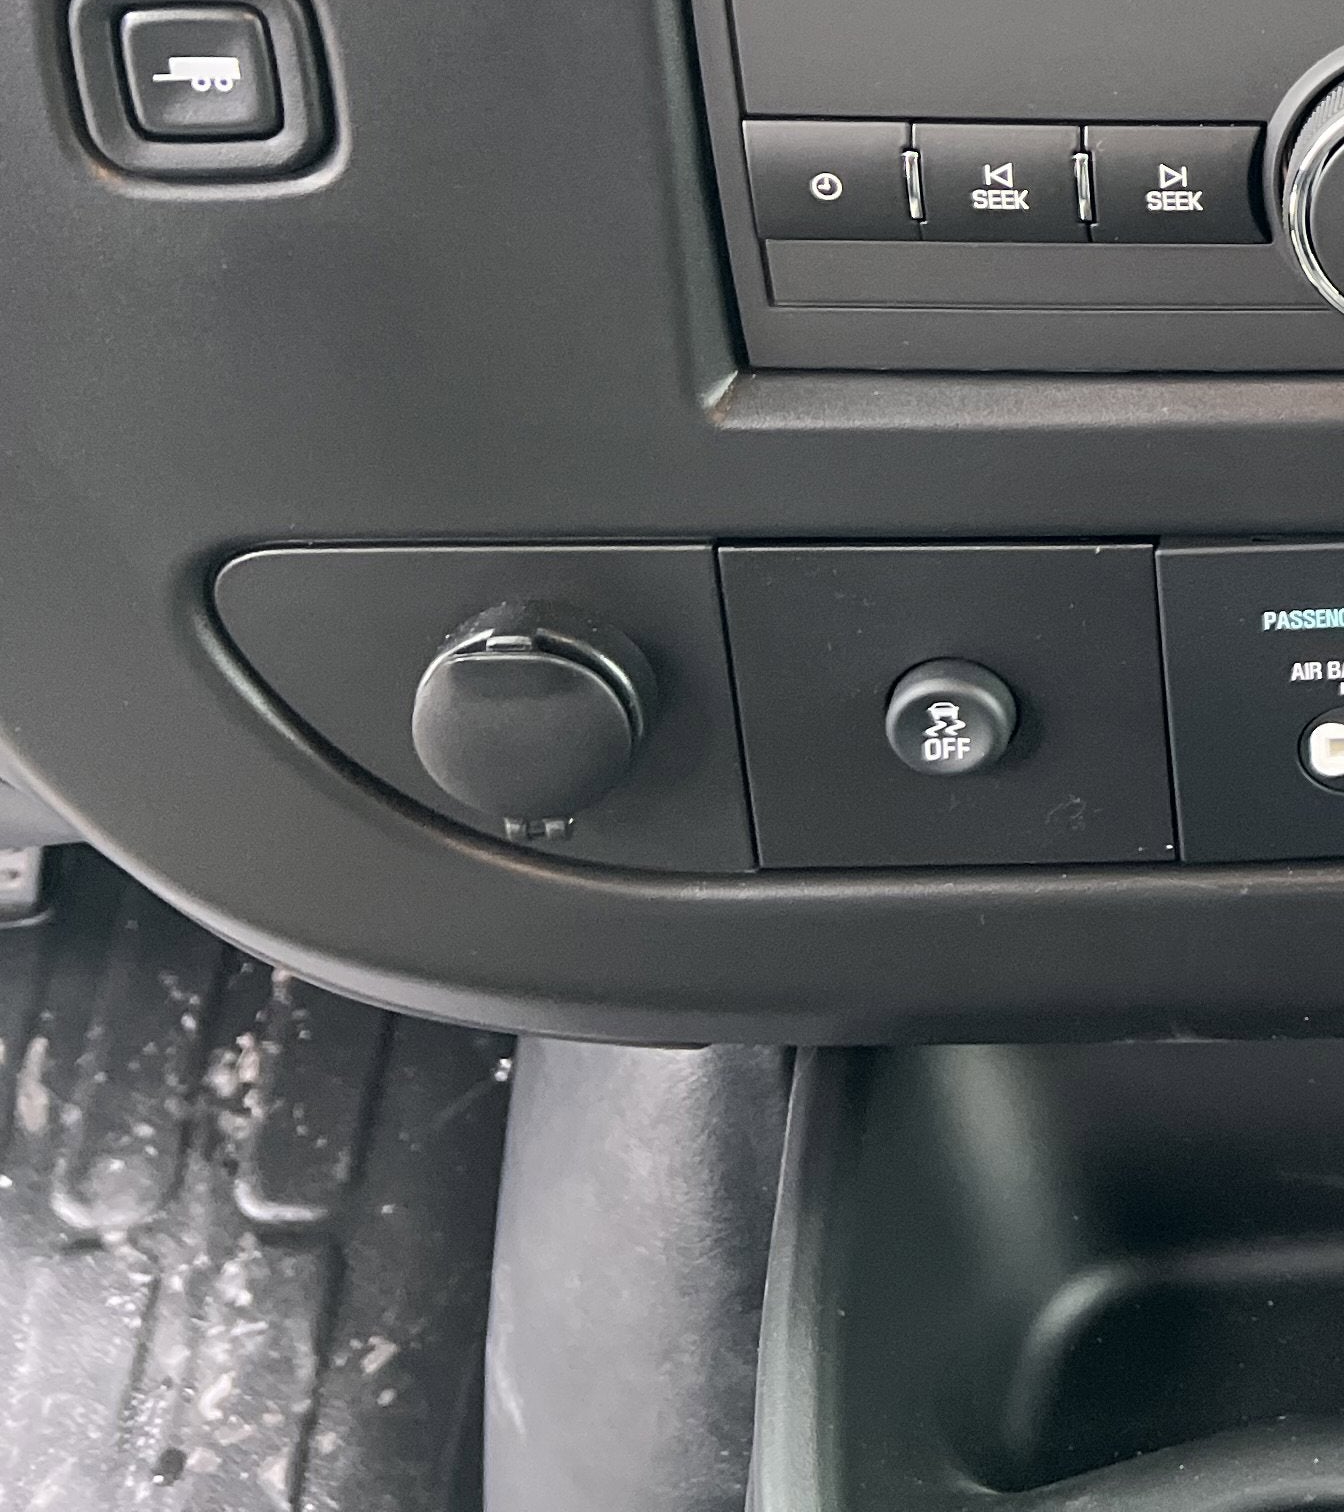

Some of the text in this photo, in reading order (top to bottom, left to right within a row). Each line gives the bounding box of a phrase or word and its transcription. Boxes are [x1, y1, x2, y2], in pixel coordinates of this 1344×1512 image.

[972, 189, 1030, 210] SEEK
[1146, 191, 1204, 211] SEEK
[1290, 661, 1323, 682] AIR
[923, 736, 971, 761] OFF
